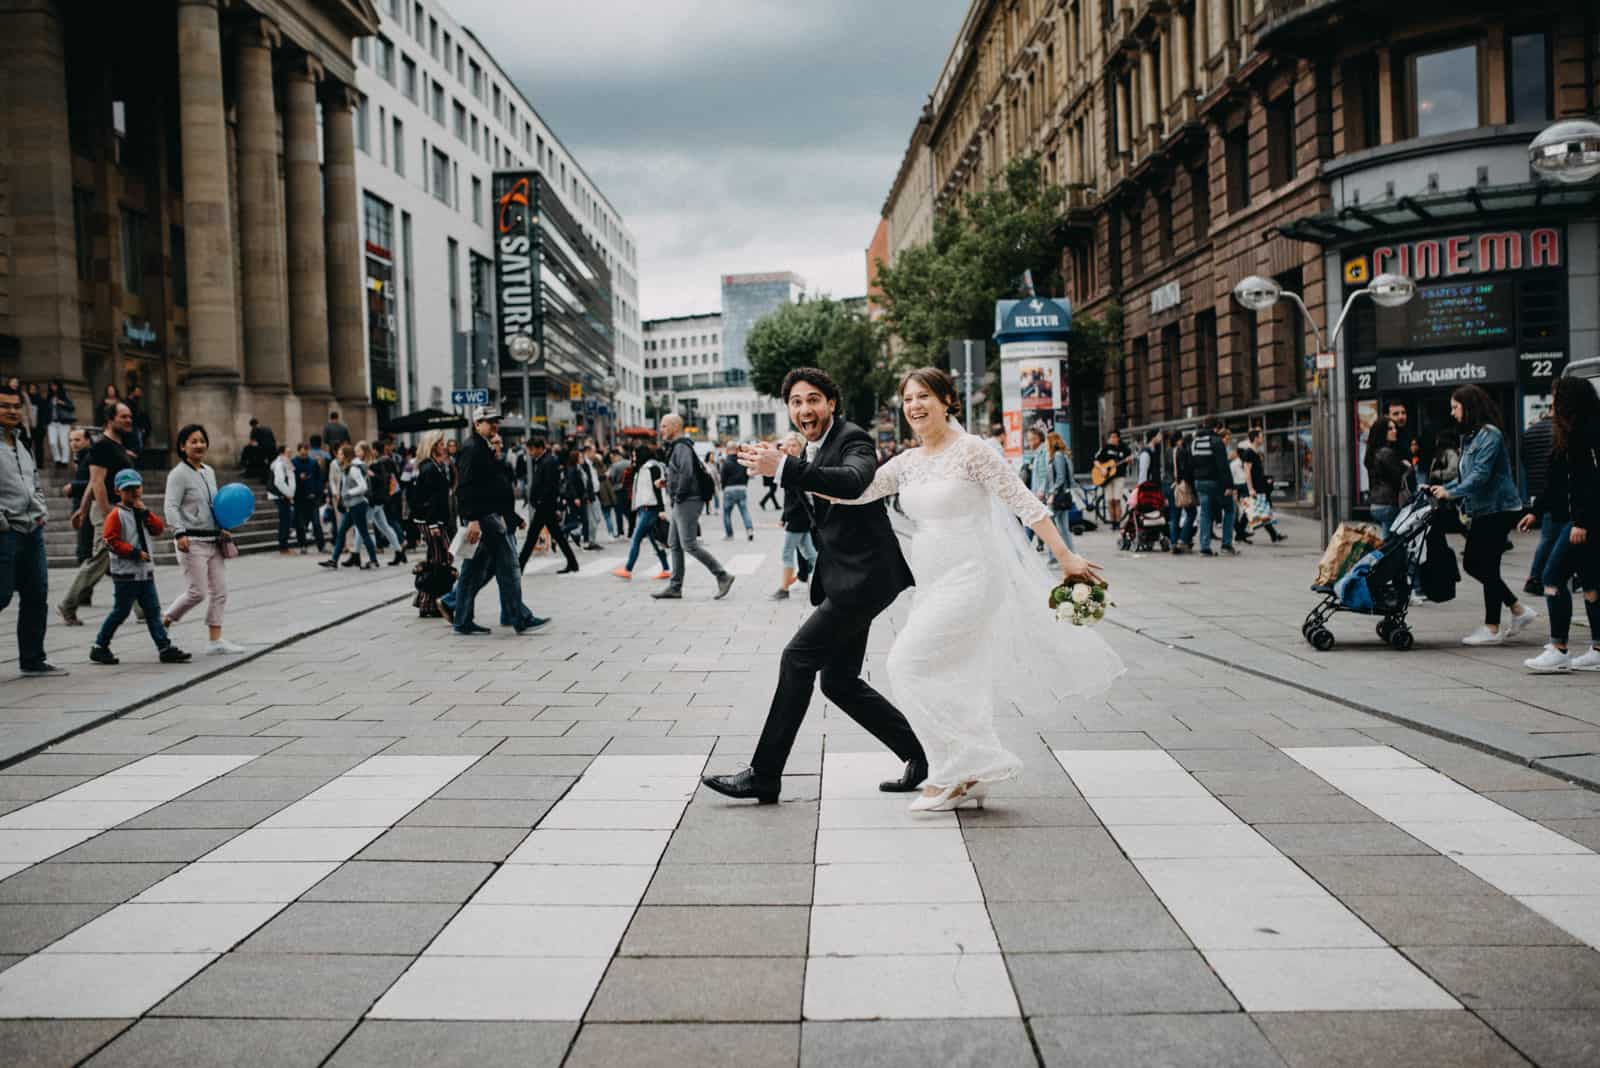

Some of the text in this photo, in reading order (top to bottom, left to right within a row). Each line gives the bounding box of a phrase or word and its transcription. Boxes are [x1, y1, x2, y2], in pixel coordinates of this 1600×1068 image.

[1372, 228, 1559, 280] CINEMA
[1014, 315, 1059, 328] KULTUR
[1398, 362, 1487, 385] marquardts
[1532, 360, 1552, 377] 22
[1358, 374, 1371, 389] 22
[466, 390, 486, 401] WC
